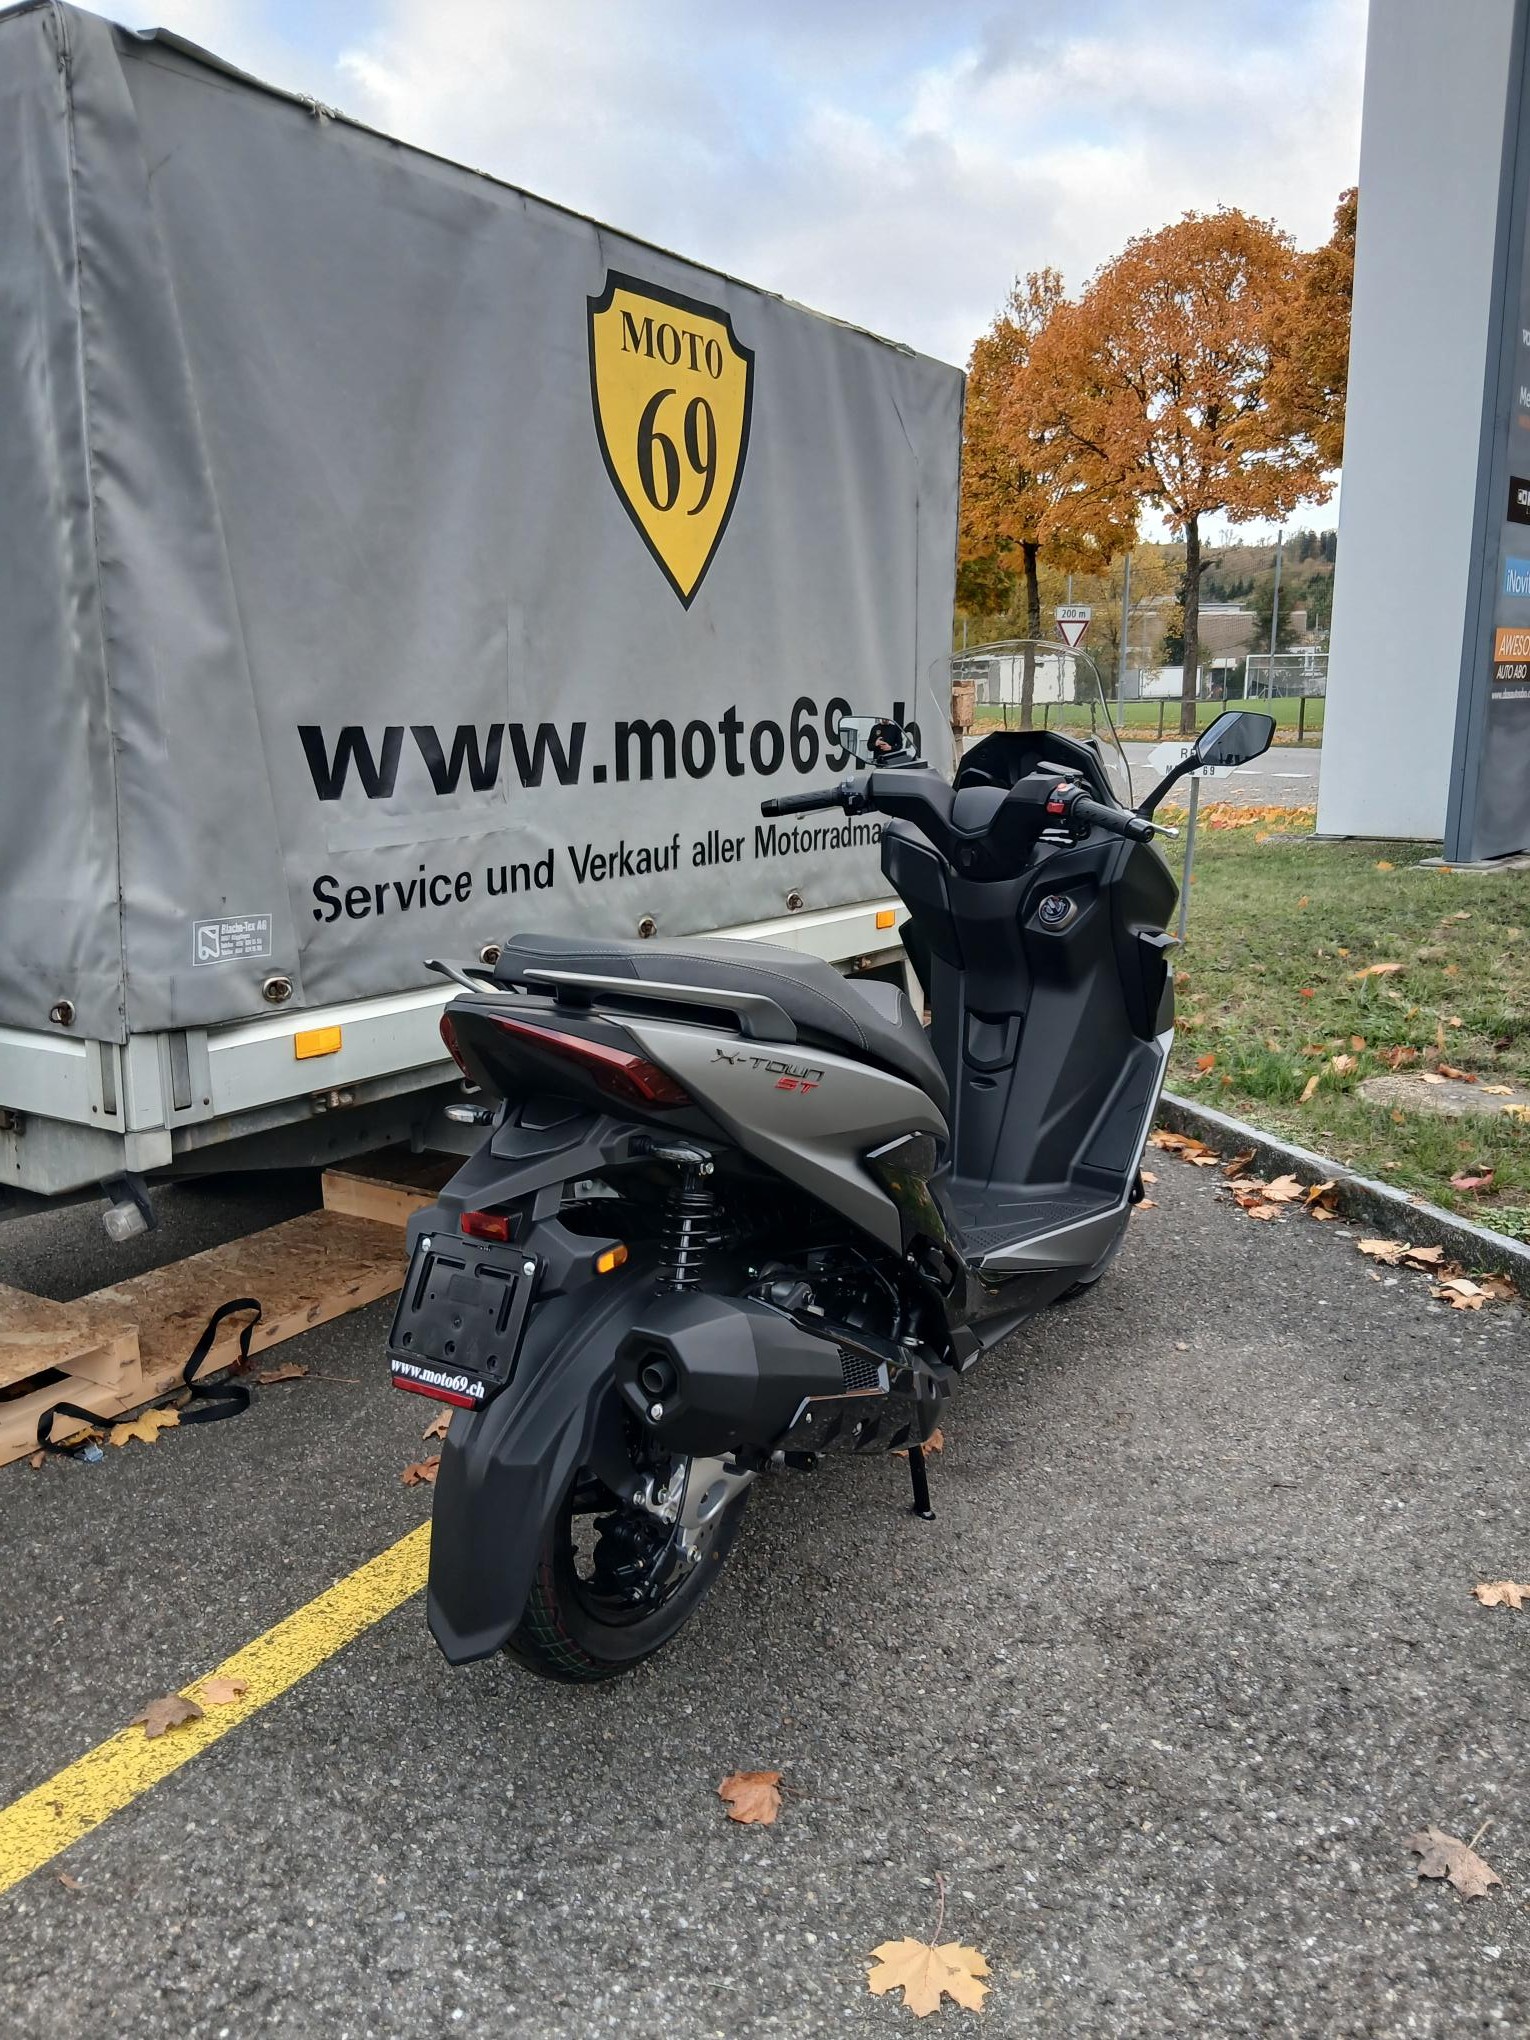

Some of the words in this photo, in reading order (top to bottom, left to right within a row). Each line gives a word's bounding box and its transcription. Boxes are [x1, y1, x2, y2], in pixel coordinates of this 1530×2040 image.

[619, 309, 723, 380] MOTO
[637, 388, 717, 516] 69
[1061, 609, 1077, 618] 200
[1499, 634, 1530, 656] AWESO
[1496, 664, 1514, 679] AUTO
[1513, 664, 1528, 679] ABO
[297, 696, 922, 801] www.moto69.h
[1203, 766, 1215, 776] 69
[312, 864, 473, 923] Service
[486, 849, 555, 895] und
[567, 833, 681, 884] Verkauf
[691, 830, 743, 867] aller
[774, 1077, 819, 1095] ST
[391, 1358, 485, 1399] www.moto69.ch
